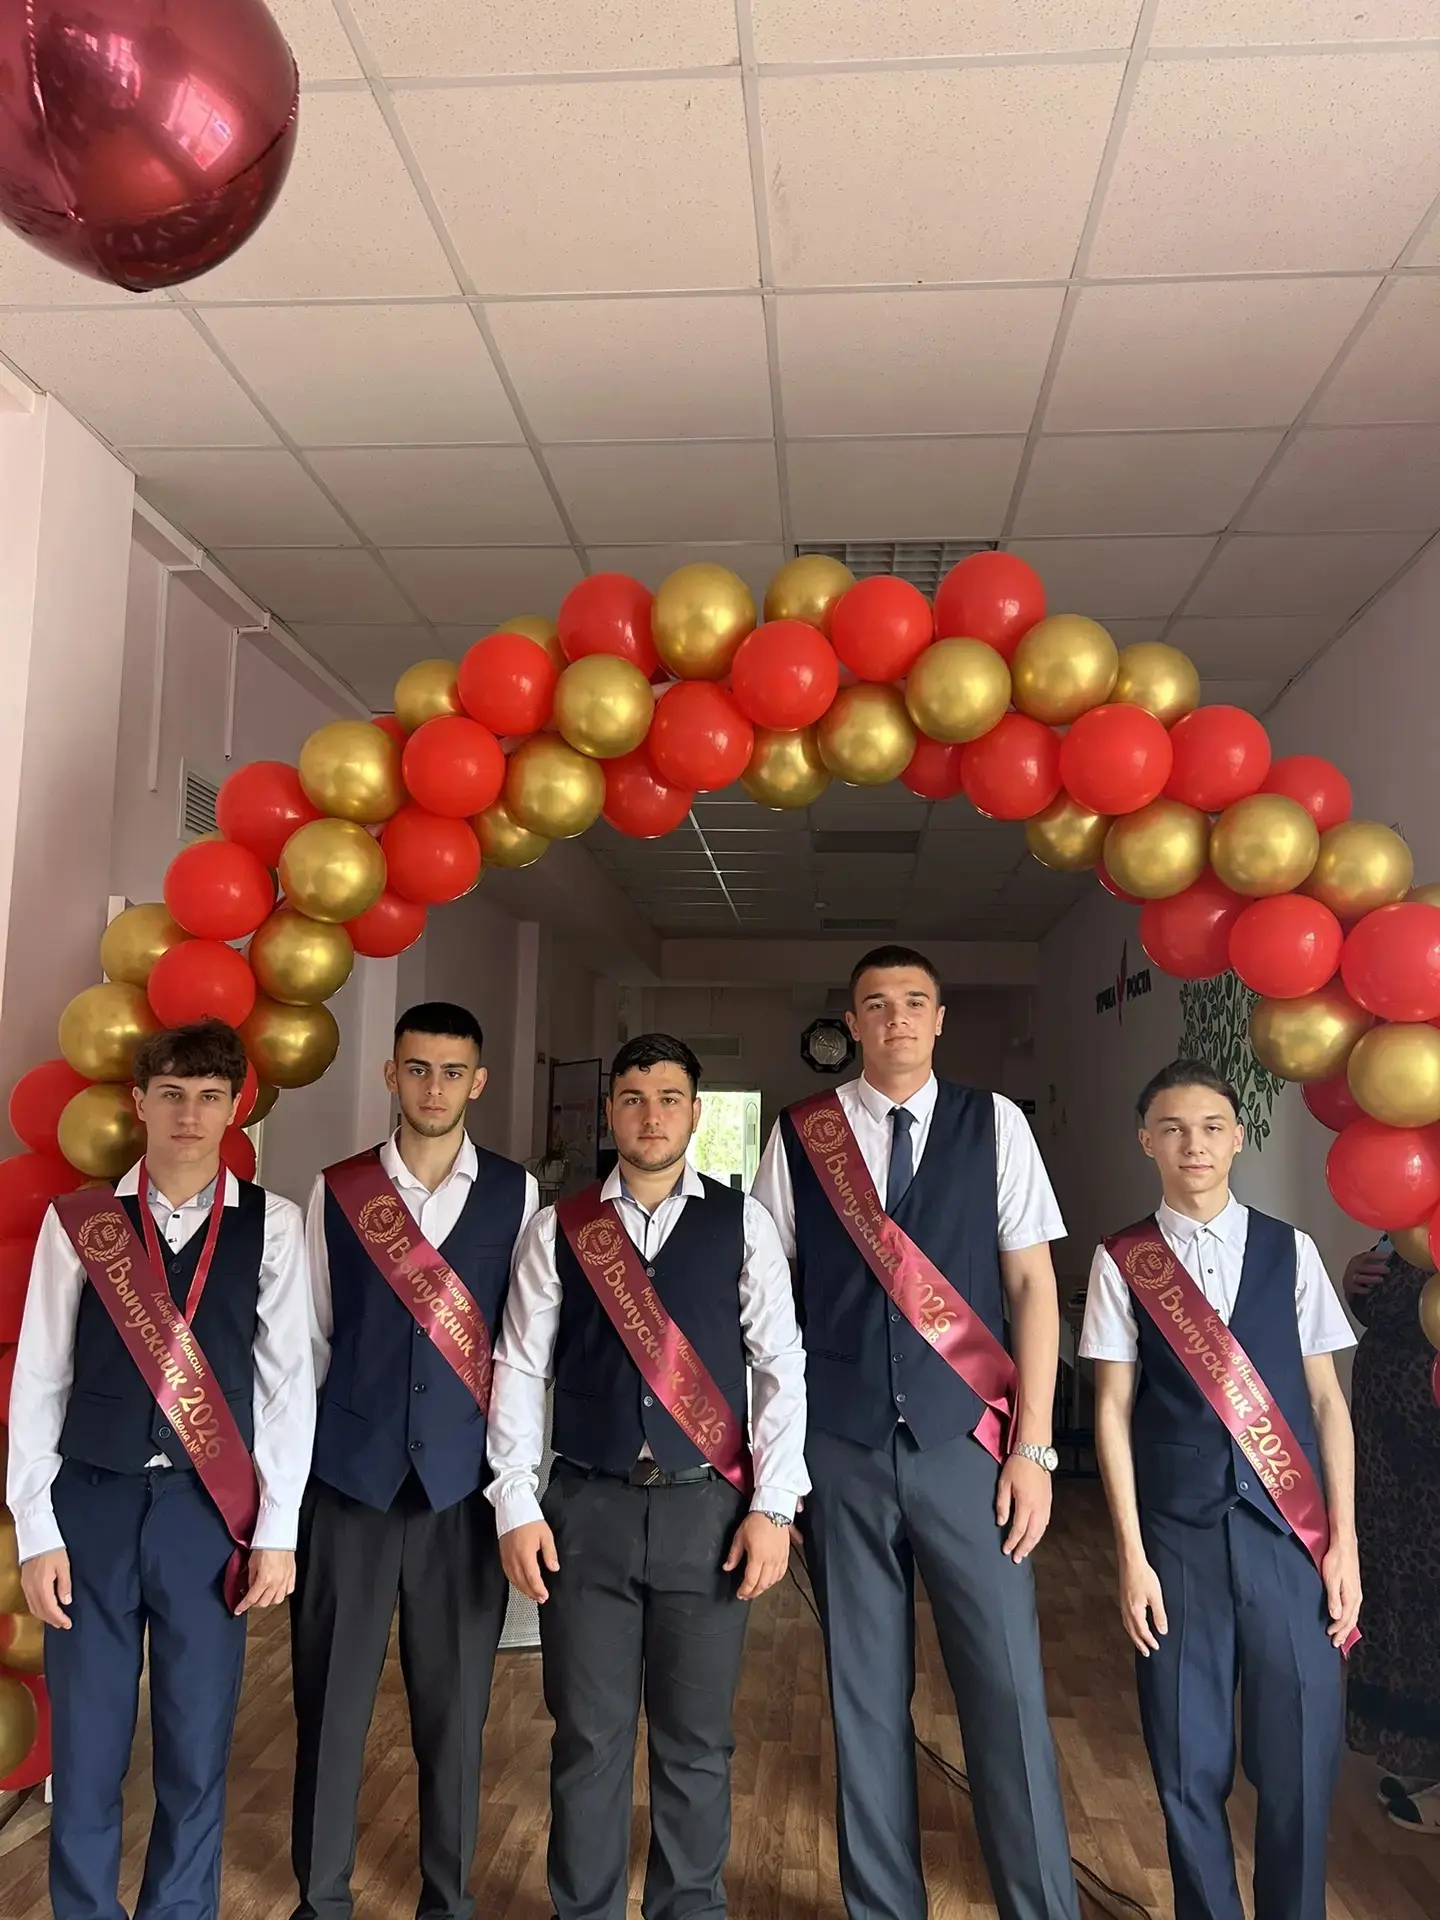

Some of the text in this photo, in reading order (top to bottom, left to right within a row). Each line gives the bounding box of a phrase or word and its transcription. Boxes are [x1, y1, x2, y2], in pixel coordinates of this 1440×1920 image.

[825, 1152, 957, 1333] Выпускник 026
[864, 1189, 885, 1227] Богаро
[386, 1236, 476, 1358] Выпускник
[433, 1266, 472, 1313] Двалидзе
[105, 1256, 228, 1460] Выпускник 2026
[150, 1291, 205, 1379] Лебедев Максим
[603, 1260, 726, 1445] Выпускнк 2026
[677, 1339, 701, 1377] Исмаи
[1204, 1315, 1270, 1413] Кривцов Никита
[168, 1403, 191, 1442] Школа
[672, 1403, 713, 1457] Школа №18
[1158, 1285, 1302, 1491] Выпускник 2026
[1237, 1431, 1283, 1500] Школа №18
